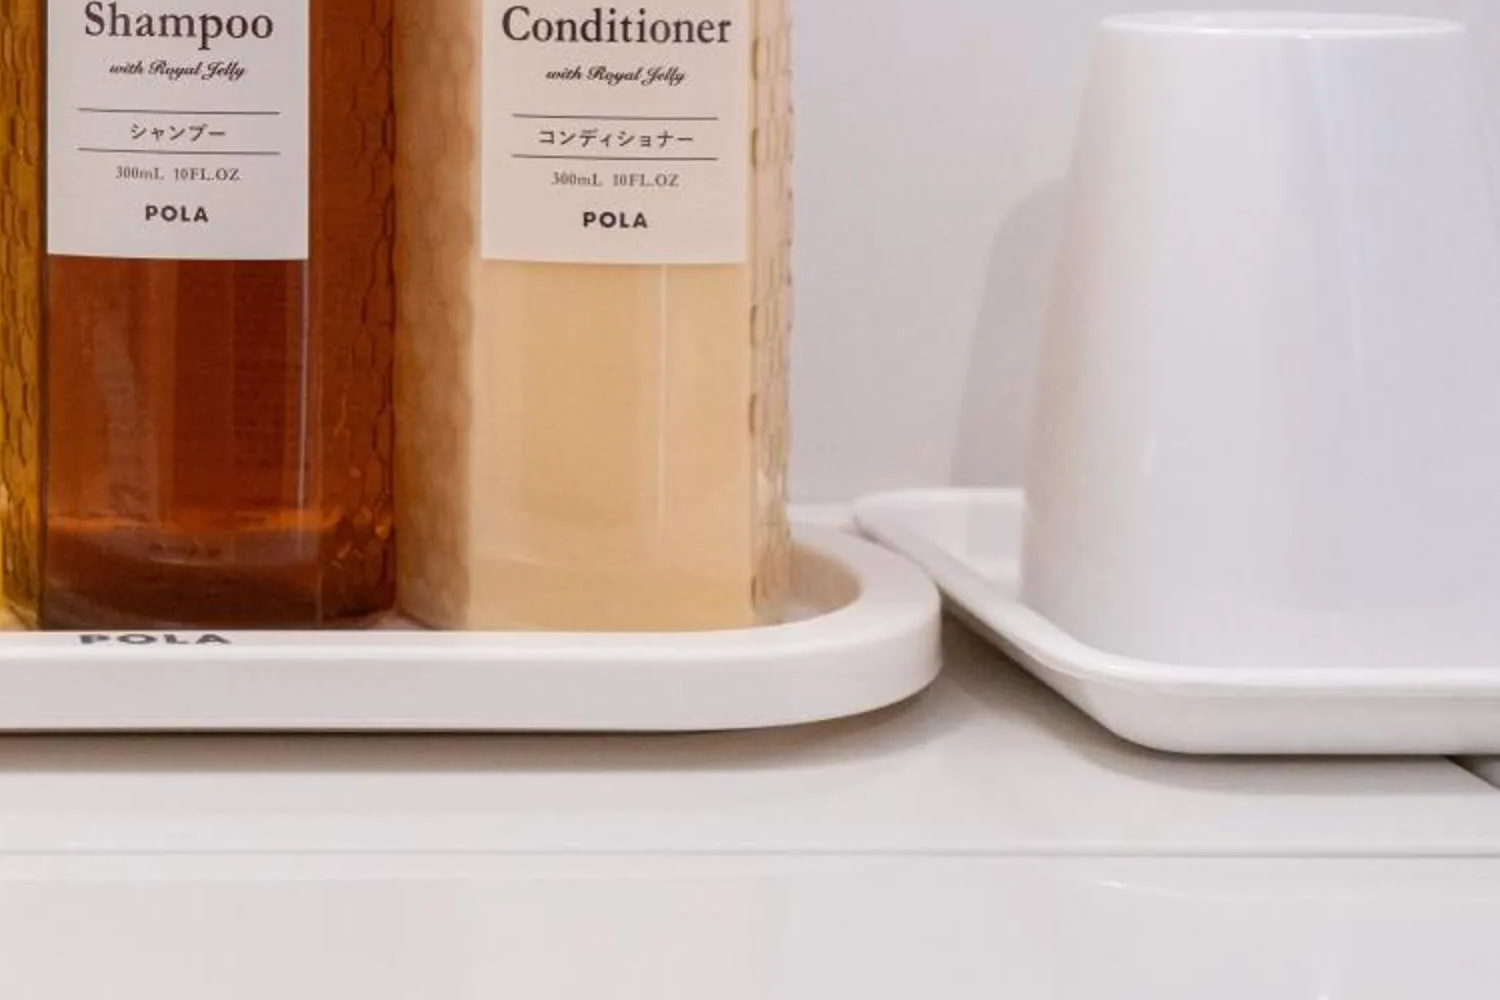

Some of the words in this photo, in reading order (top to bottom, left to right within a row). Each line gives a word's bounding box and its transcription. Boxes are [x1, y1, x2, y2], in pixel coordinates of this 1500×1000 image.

[84, 1, 274, 50] Shampoo
[502, 6, 731, 43] Conditioner
[109, 62, 144, 75] with
[147, 60, 201, 79] Royal
[202, 61, 246, 80] Jelly
[546, 67, 582, 80] with
[585, 66, 640, 84] Royal
[641, 66, 686, 85] Jelly
[130, 123, 226, 141] シャンプー
[538, 129, 694, 147] コンディショナー
[115, 166, 164, 180] 300mL
[551, 172, 603, 187] 300mL
[145, 205, 209, 223] POLA
[583, 211, 647, 228] POLA
[79, 634, 230, 644] POLA
